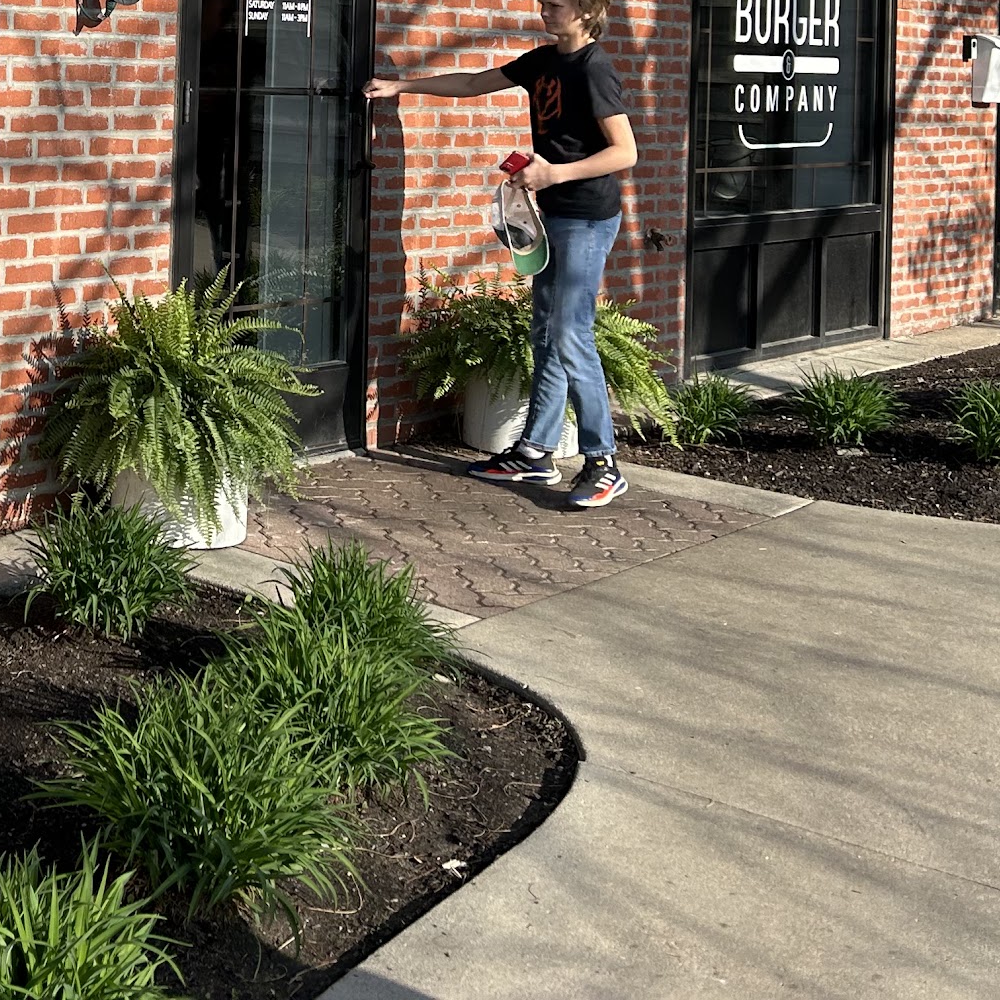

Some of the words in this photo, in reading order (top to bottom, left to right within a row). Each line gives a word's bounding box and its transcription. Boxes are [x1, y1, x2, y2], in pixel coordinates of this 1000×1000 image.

[248, 0, 275, 10] SATURDAY
[248, 11, 269, 21] SUNDAY
[734, 83, 838, 113] COMPANY
